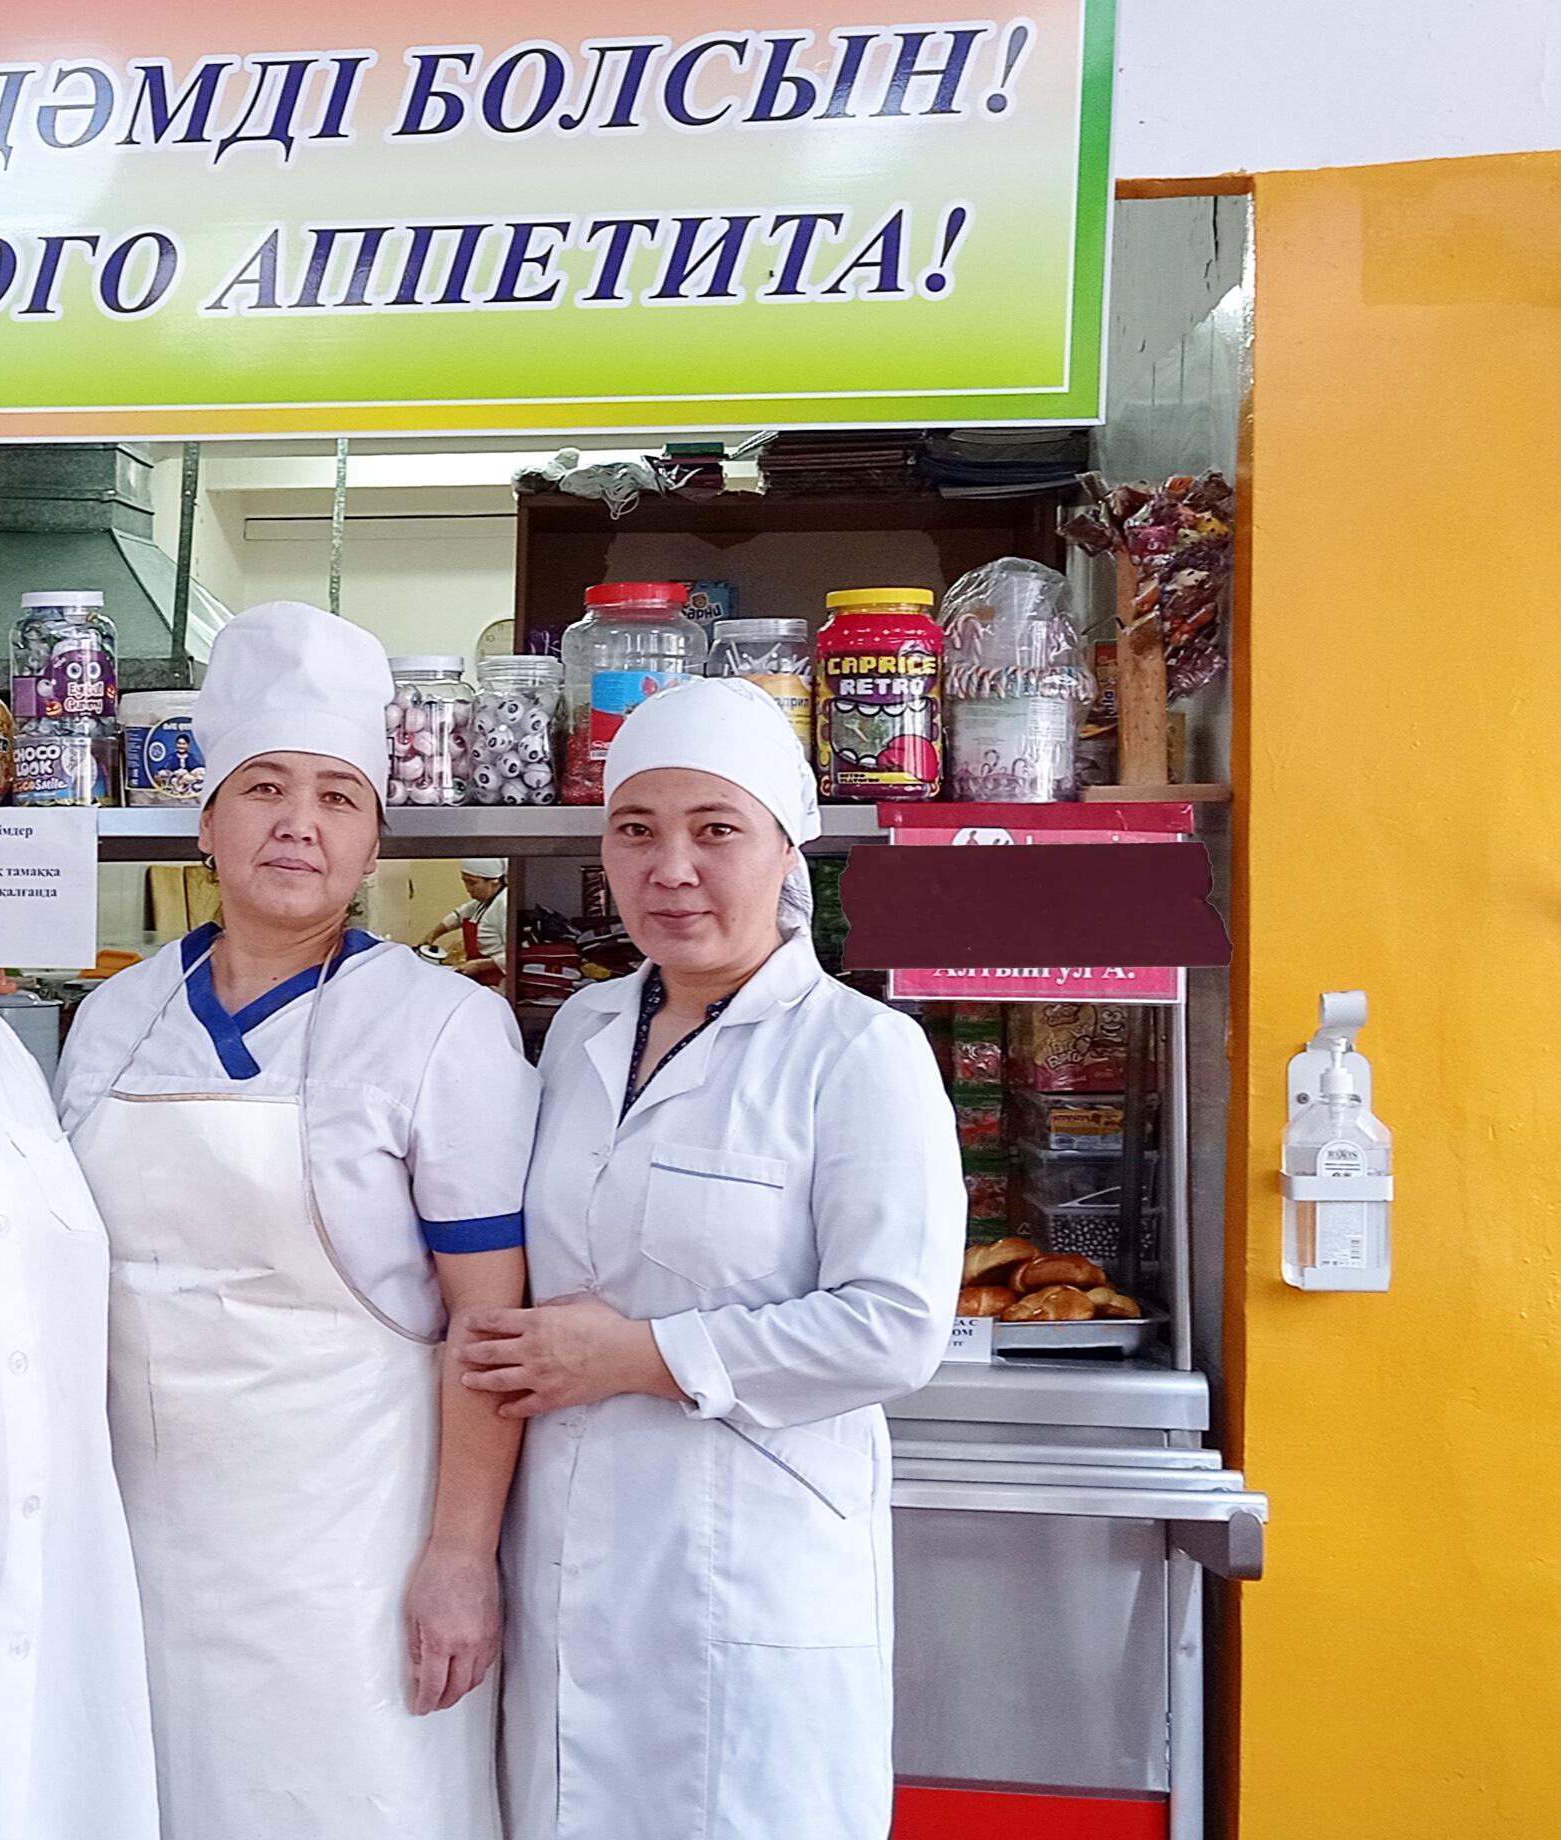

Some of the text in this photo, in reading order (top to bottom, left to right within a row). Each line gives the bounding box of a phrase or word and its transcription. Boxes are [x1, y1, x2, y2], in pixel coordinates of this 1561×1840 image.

[390, 26, 1031, 138] БОЛСЫН!
[204, 206, 967, 310] АППЕТИТА!
[827, 656, 936, 675] CAPRICE
[840, 678, 925, 695] RETRO
[15, 761, 54, 777] LOOK
[7, 868, 61, 878] тамаққа
